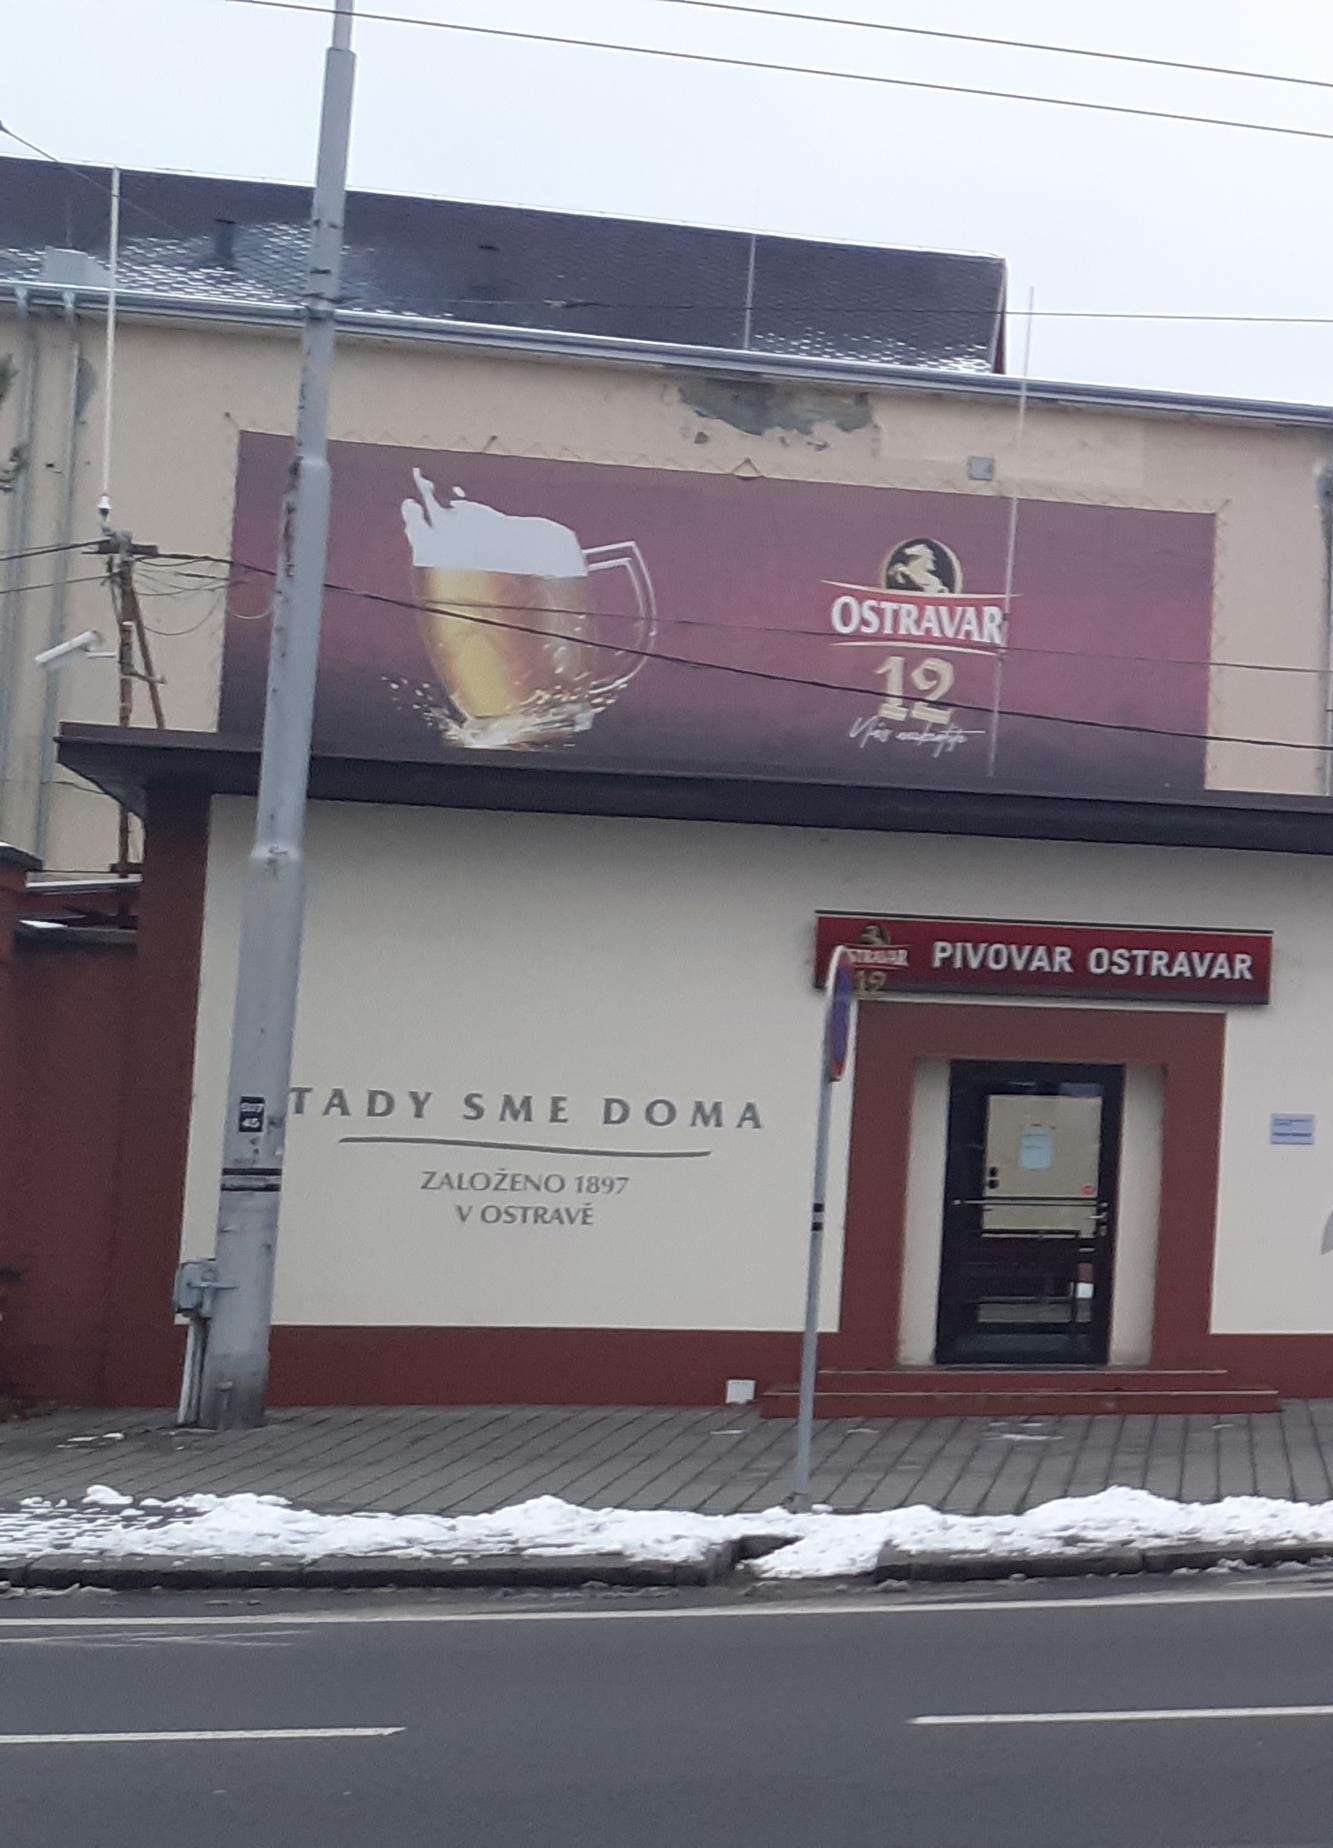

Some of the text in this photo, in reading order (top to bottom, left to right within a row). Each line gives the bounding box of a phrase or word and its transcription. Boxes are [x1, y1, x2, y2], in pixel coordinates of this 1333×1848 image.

[831, 595, 1004, 645] OSTRAVAR
[875, 656, 954, 724] 12
[932, 942, 1252, 980] PIVOVAR OSTRAVAR
[290, 1087, 764, 1129] TADY SME DOMA
[421, 1168, 629, 1195] ZALOŽENO 1897
[456, 1202, 594, 1226] V OSTRAVĚ
